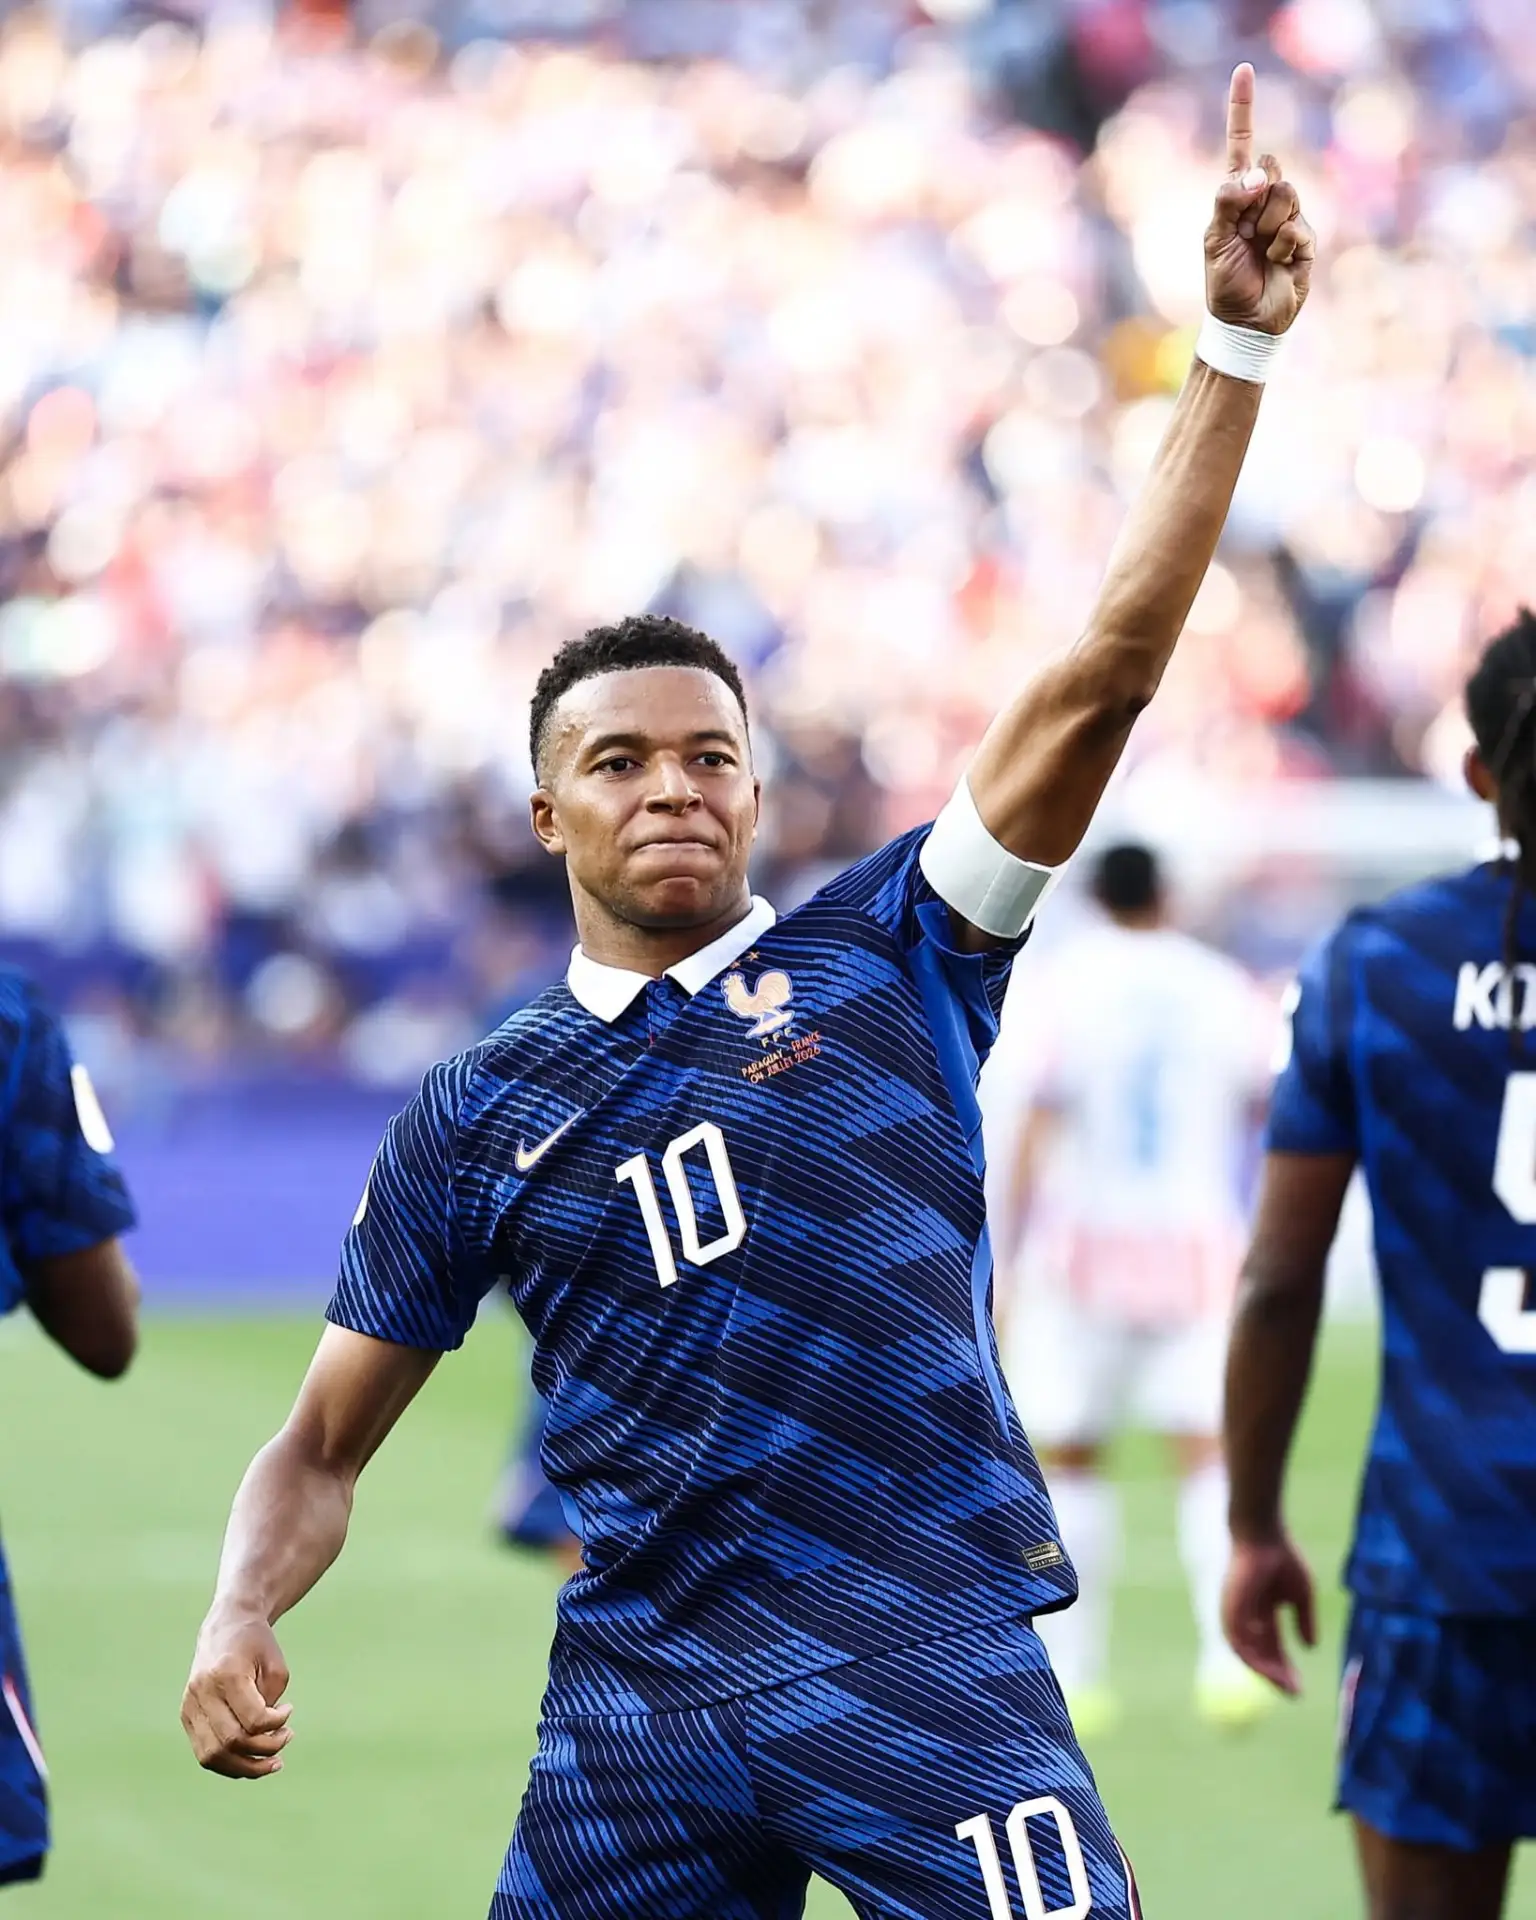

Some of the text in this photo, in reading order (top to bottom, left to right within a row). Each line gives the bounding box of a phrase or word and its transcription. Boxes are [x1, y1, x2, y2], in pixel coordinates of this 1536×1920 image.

[741, 1048, 783, 1077] PARAGUAY
[791, 1031, 821, 1052] FRANCE
[750, 1044, 821, 1084] 04 JUILLET 2026
[614, 1121, 747, 1288] 10
[955, 1795, 1093, 1920] 10
